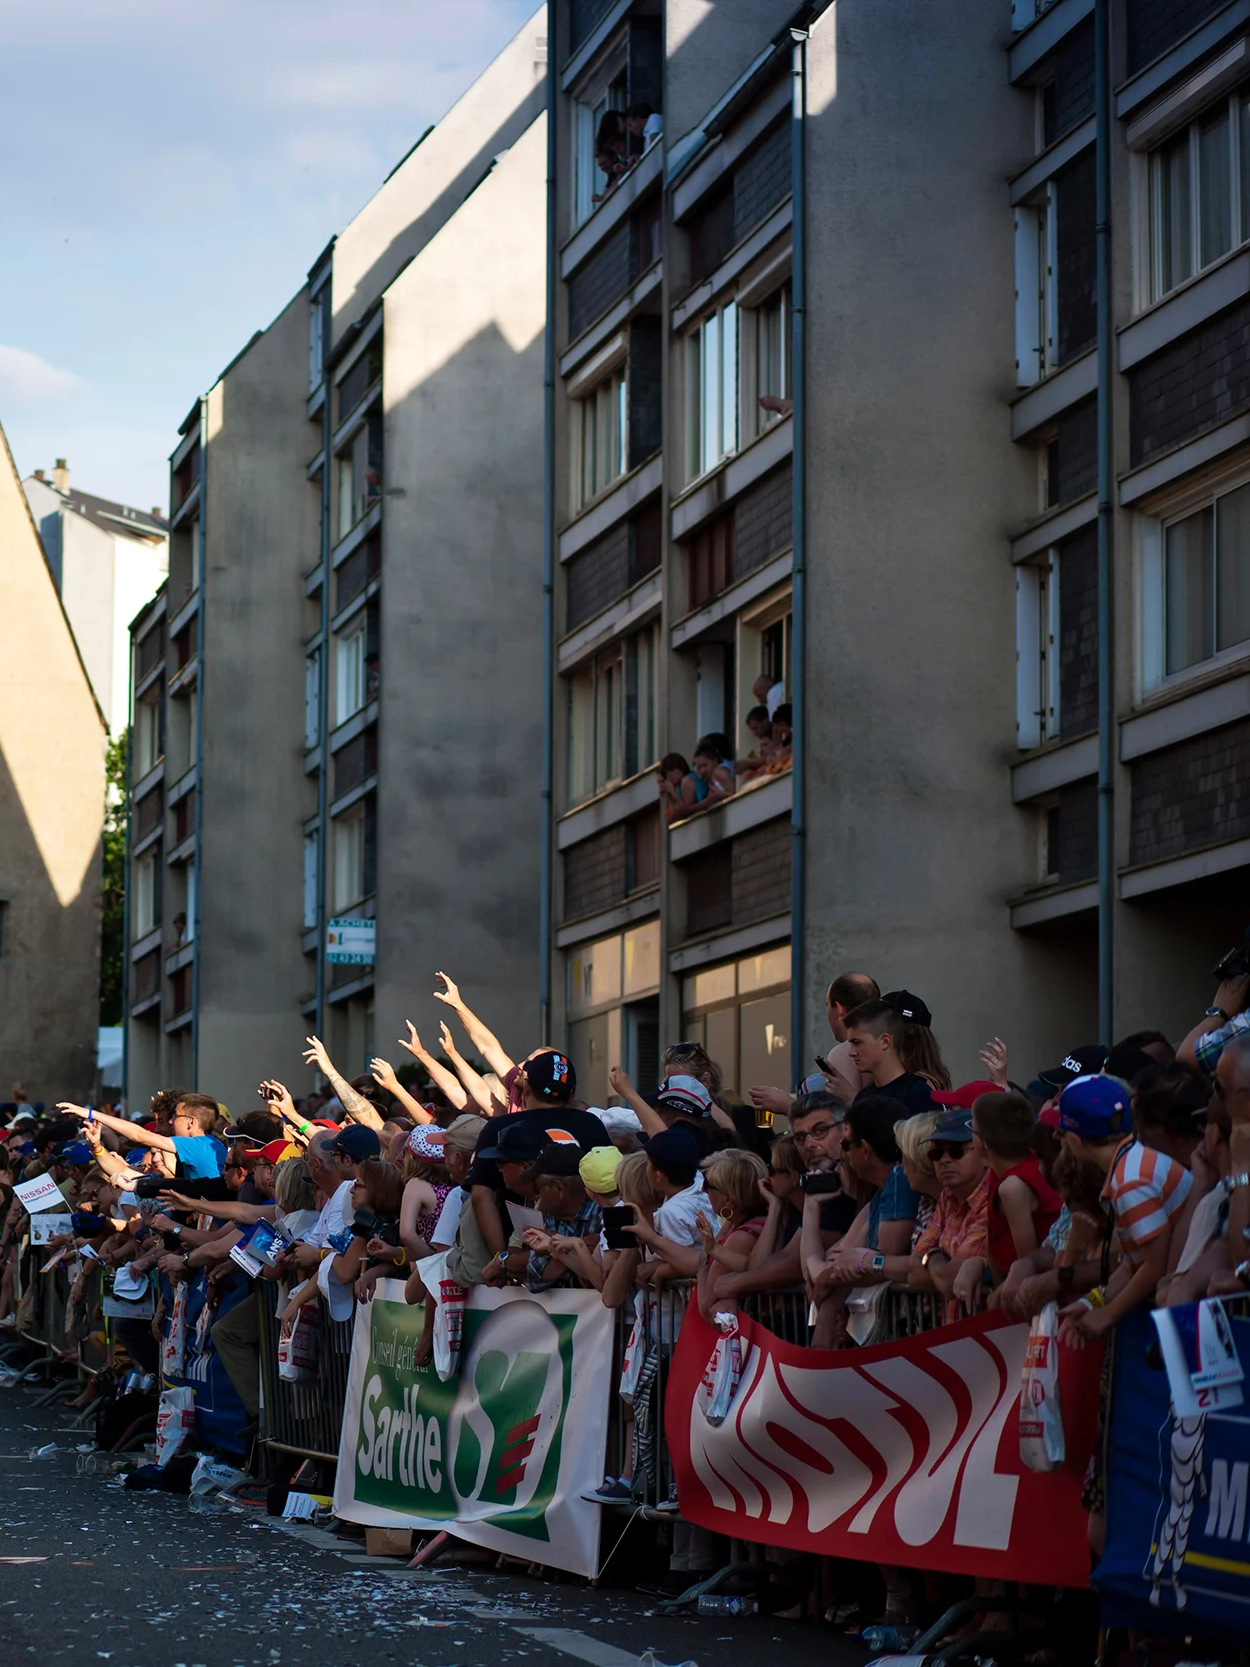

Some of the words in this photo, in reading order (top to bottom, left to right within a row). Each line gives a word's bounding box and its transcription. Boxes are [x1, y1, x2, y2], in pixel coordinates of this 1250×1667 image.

[19, 1182, 56, 1201] NISSAN
[371, 1325, 399, 1369] Conseil
[395, 1335, 429, 1381] géné
[356, 1373, 443, 1495] Sarthe
[689, 1322, 1040, 1552] MOTUL
[1203, 1458, 1250, 1546] M
